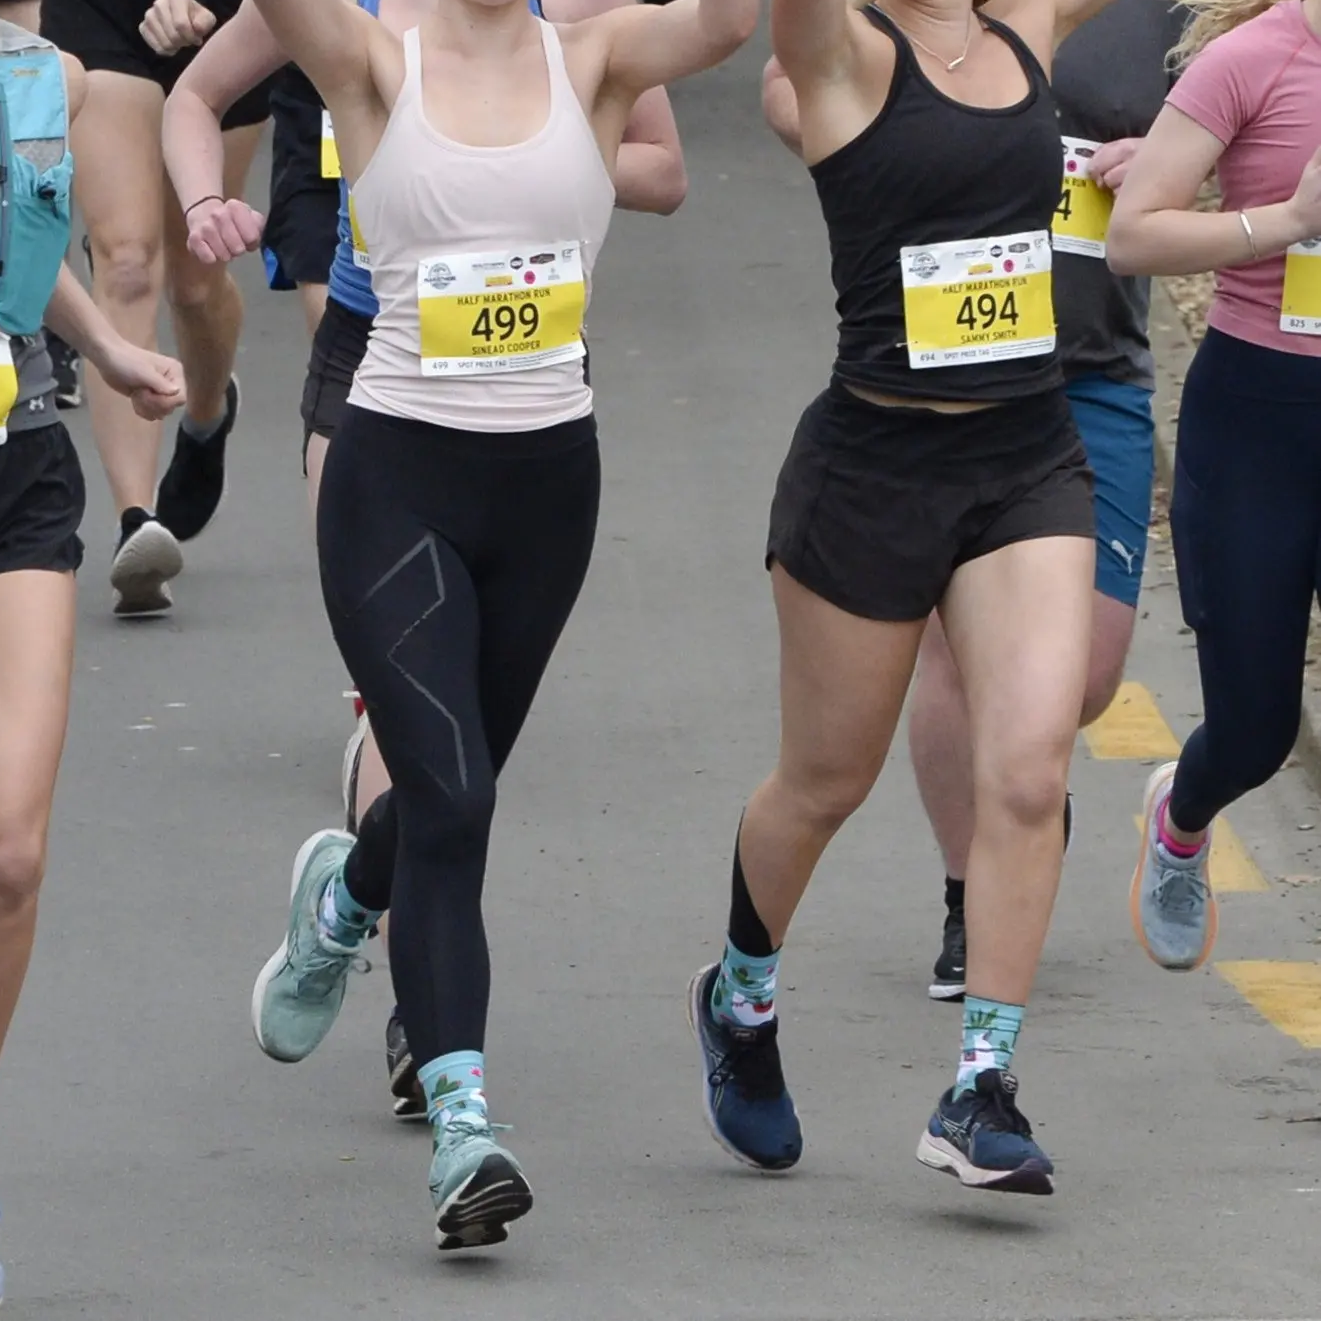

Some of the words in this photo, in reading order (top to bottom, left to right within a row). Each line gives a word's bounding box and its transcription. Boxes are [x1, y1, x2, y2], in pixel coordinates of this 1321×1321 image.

[942, 284, 963, 294] HALF
[966, 279, 1010, 292] MARATHON
[1012, 277, 1028, 286] RUN
[457, 296, 479, 305] HALF
[483, 291, 531, 303] MARATHON
[534, 288, 551, 297] RUN
[956, 291, 1019, 330] 494
[471, 302, 539, 342] 499
[960, 332, 991, 345] SAMMY
[993, 330, 1018, 341] SMITH
[472, 344, 505, 355] SINEAD
[507, 340, 541, 352] COOPER
